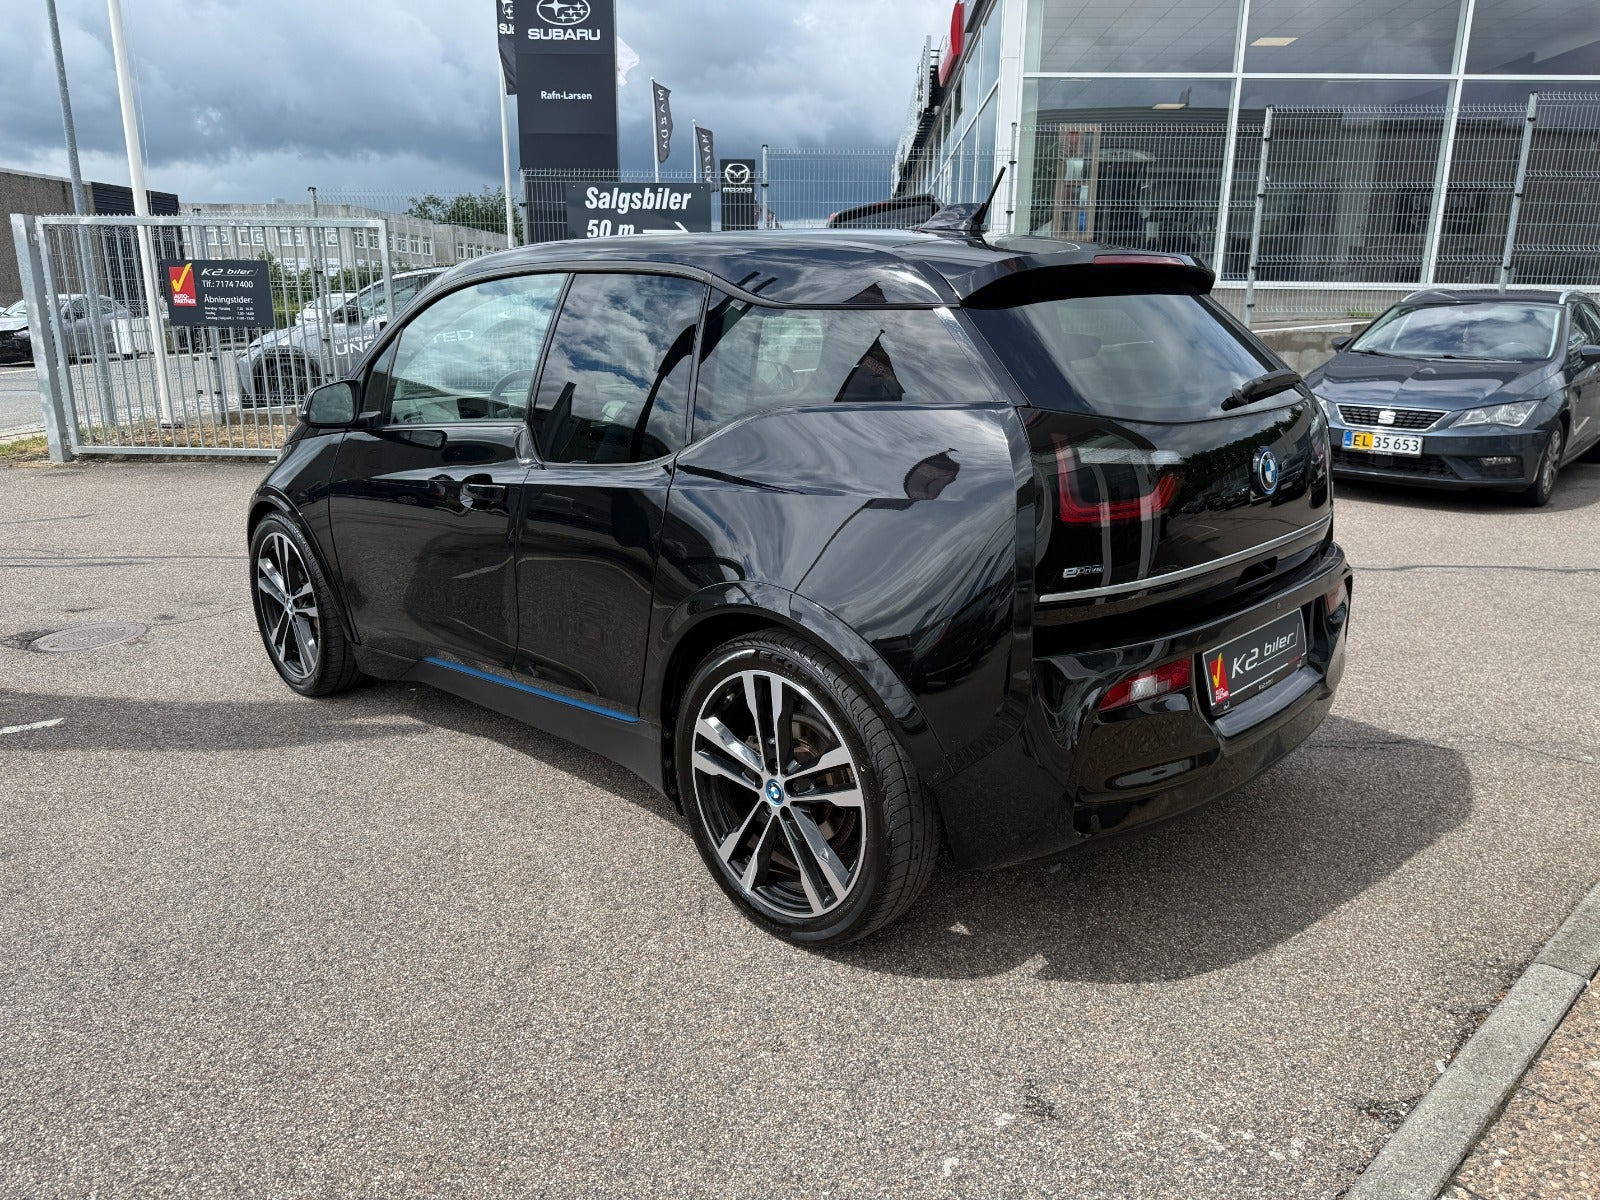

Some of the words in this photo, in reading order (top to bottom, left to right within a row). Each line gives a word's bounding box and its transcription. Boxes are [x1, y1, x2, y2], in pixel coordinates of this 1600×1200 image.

[527, 28, 601, 41] SUBARU
[540, 90, 593, 100] Rafn-Larsen
[585, 186, 692, 214] Salgsbiler
[586, 219, 612, 238] 50
[618, 223, 635, 236] m
[201, 267, 224, 276] K2
[202, 280, 215, 288] Tlf.:
[216, 280, 234, 288] 7174
[235, 280, 254, 288] 7400
[204, 293, 254, 305] Åbningstider:
[1353, 434, 1369, 447] EL
[1373, 436, 1390, 449] 35
[1393, 438, 1419, 452] 653
[1231, 647, 1259, 679] K2
[1263, 632, 1295, 656] biler
